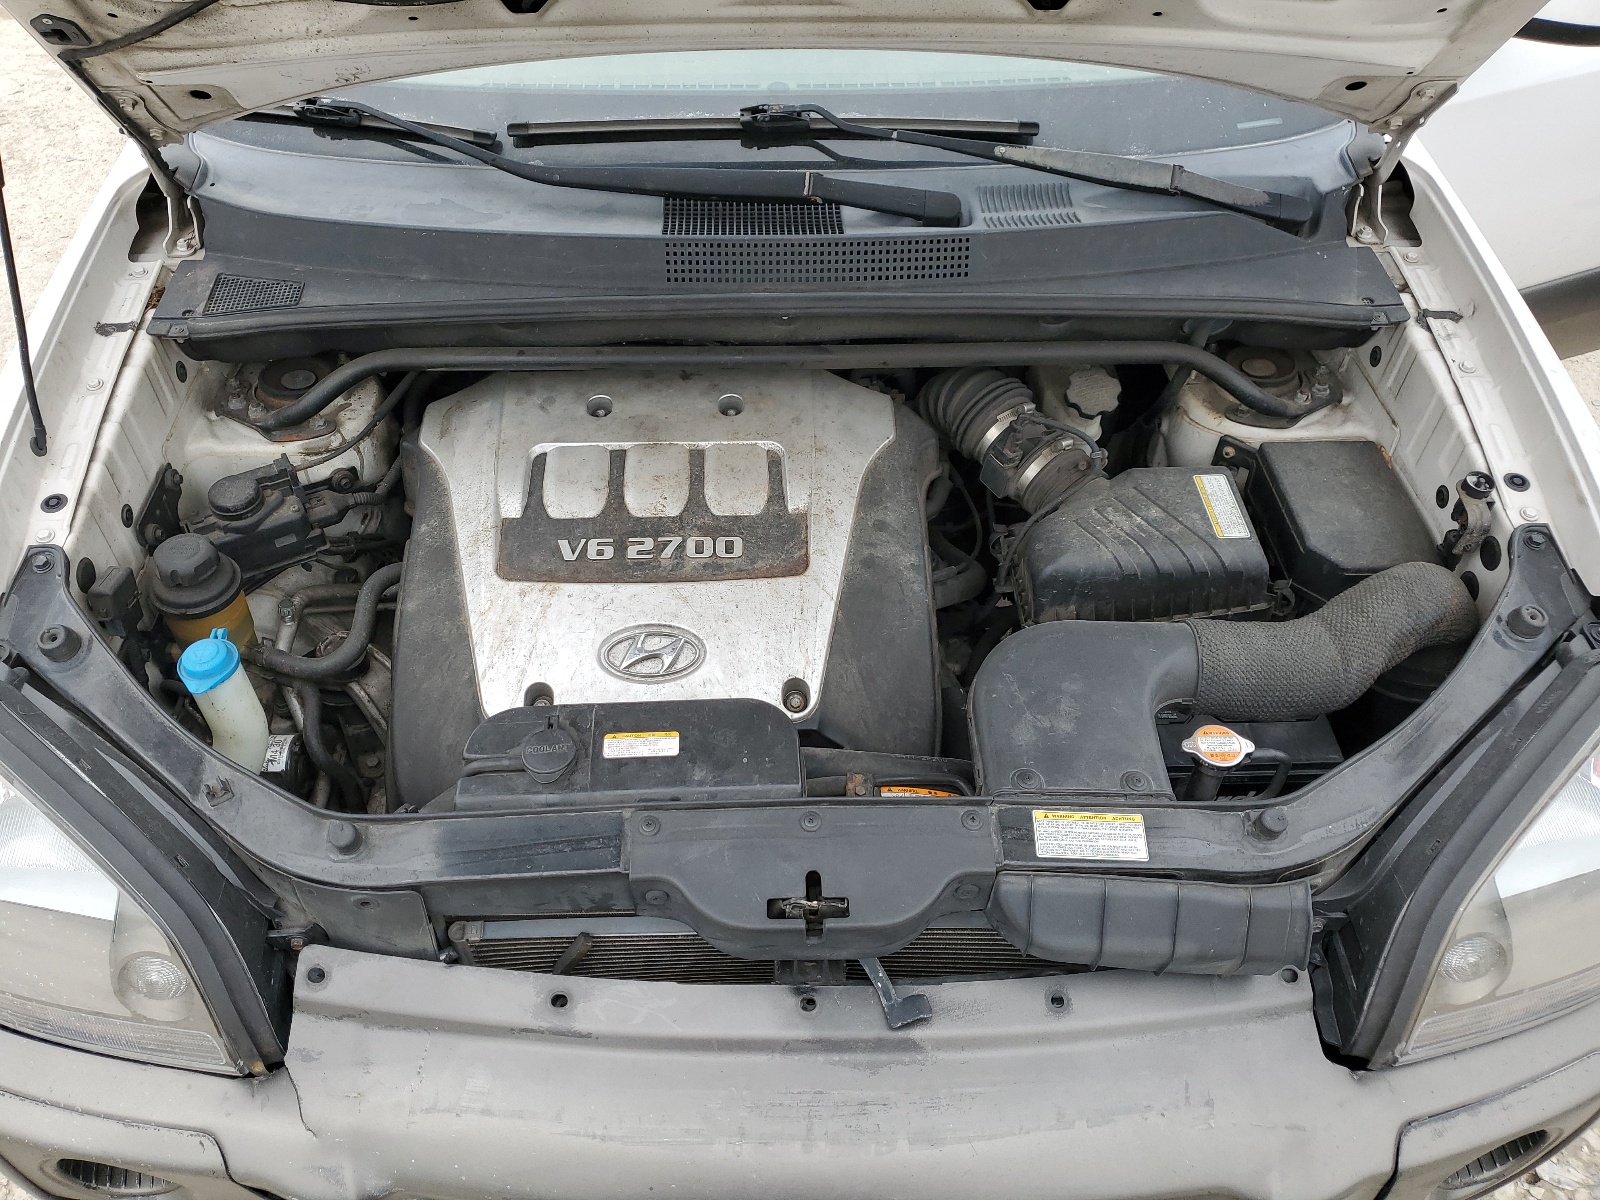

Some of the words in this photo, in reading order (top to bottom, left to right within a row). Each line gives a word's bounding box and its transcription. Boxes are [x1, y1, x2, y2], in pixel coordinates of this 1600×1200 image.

[557, 538, 615, 562] V6
[626, 536, 744, 561] 2700
[526, 742, 571, 754] COOLANT
